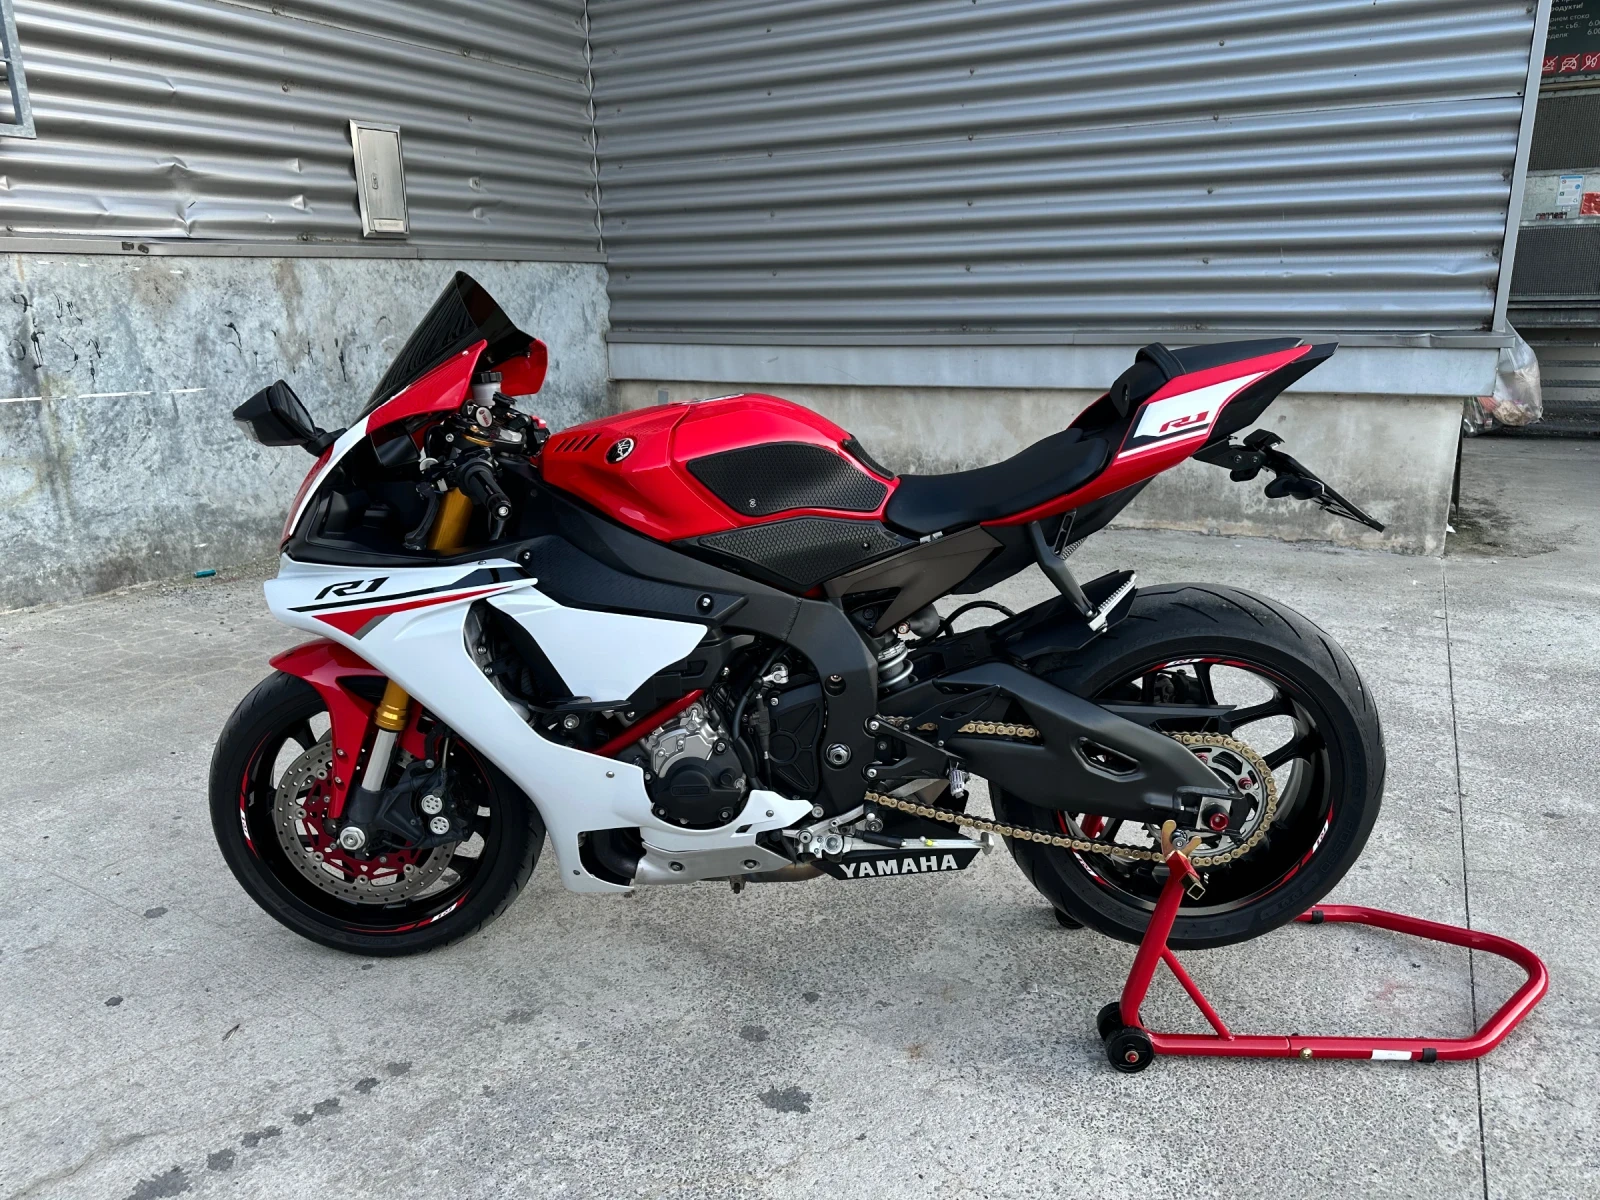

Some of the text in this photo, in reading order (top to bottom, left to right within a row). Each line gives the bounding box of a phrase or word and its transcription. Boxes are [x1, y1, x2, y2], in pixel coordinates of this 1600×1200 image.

[1159, 410, 1209, 433] R1
[314, 576, 390, 600] R1
[838, 854, 958, 878] YAMAHA
